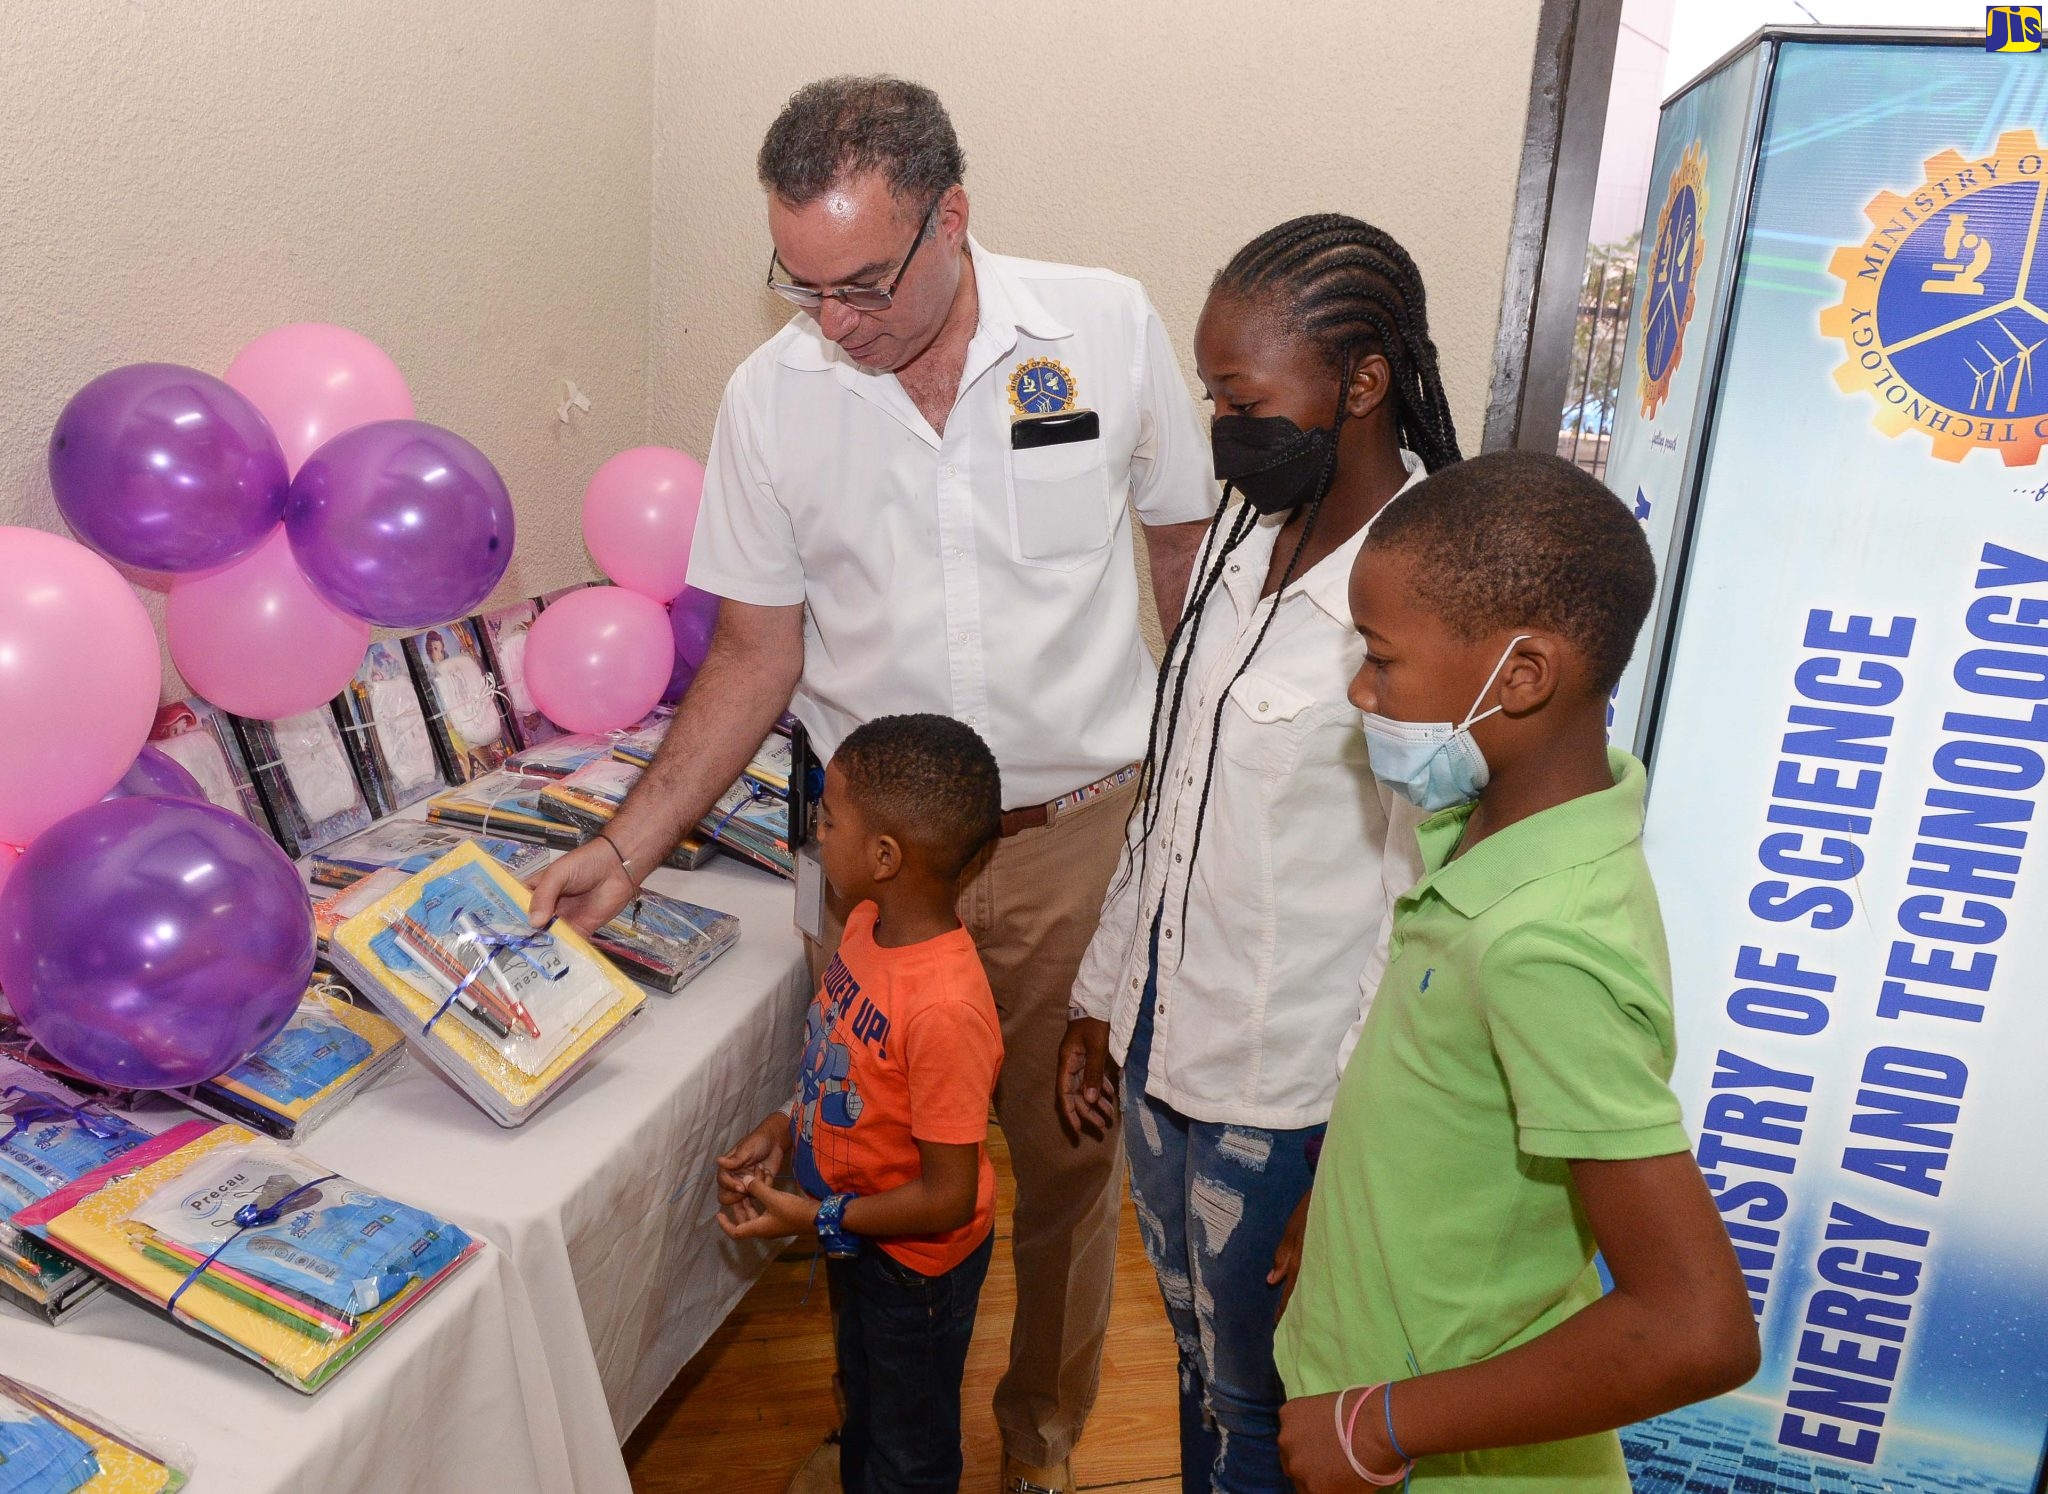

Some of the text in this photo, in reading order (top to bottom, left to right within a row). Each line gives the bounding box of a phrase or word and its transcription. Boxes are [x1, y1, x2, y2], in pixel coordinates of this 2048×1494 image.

[1857, 155, 2048, 282] MINISTRY O
[1850, 307, 2018, 442] TECHNOLOGY
[513, 956, 561, 992] Prcau
[851, 997, 892, 1060] UP!
[1696, 608, 1917, 1334] ISTRY OF SCIENCE
[1778, 542, 2048, 1465] ENERGY AND TECHNOLOGY
[190, 1172, 246, 1211] Precau
